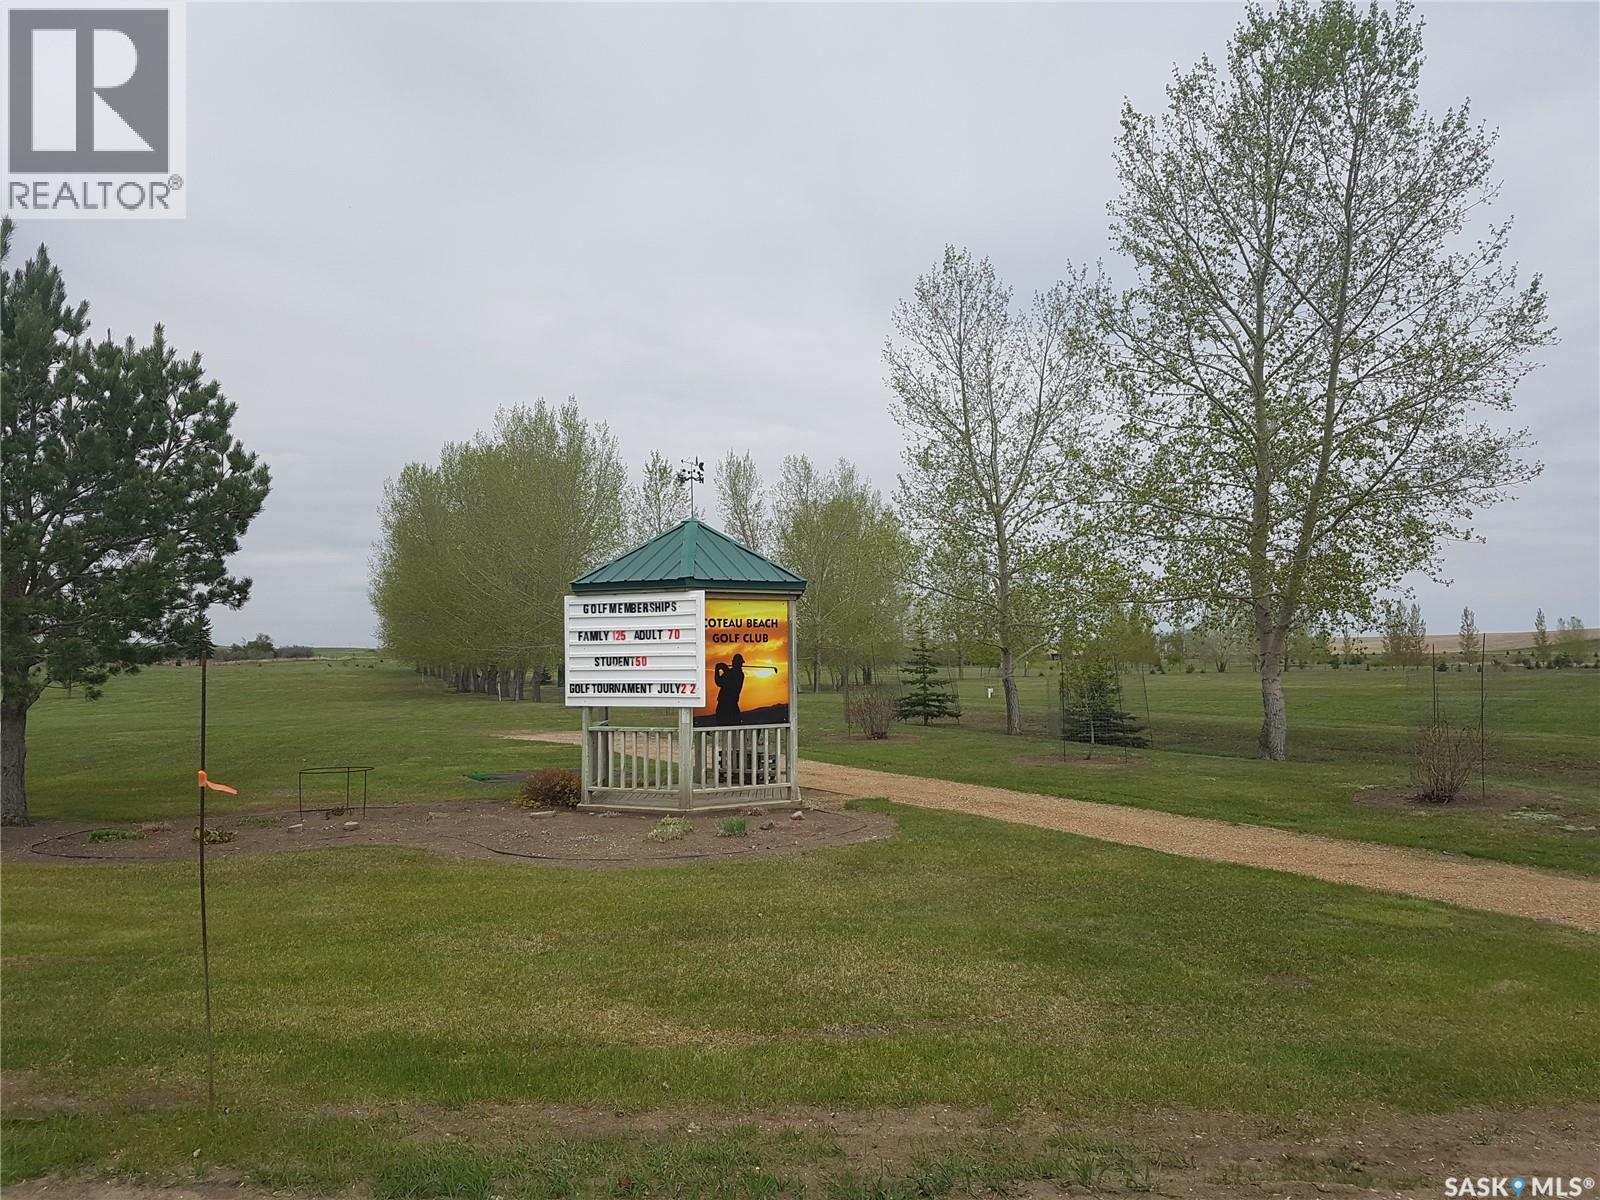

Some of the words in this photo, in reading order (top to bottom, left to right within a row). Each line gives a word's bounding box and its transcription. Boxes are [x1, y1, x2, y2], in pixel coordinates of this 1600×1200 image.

[583, 603, 608, 614] GOLF
[609, 601, 677, 614] MEMBERSHIPS
[746, 618, 778, 628] BEACH
[578, 630, 609, 642] FAMILY
[612, 630, 626, 641] 125
[634, 629, 663, 640] ADULT
[667, 629, 680, 640] 70
[712, 633, 740, 643] GOLF
[743, 633, 769, 643] CLUB
[569, 683, 590, 694] GOLF
[591, 683, 652, 694] TOURNAMENT
